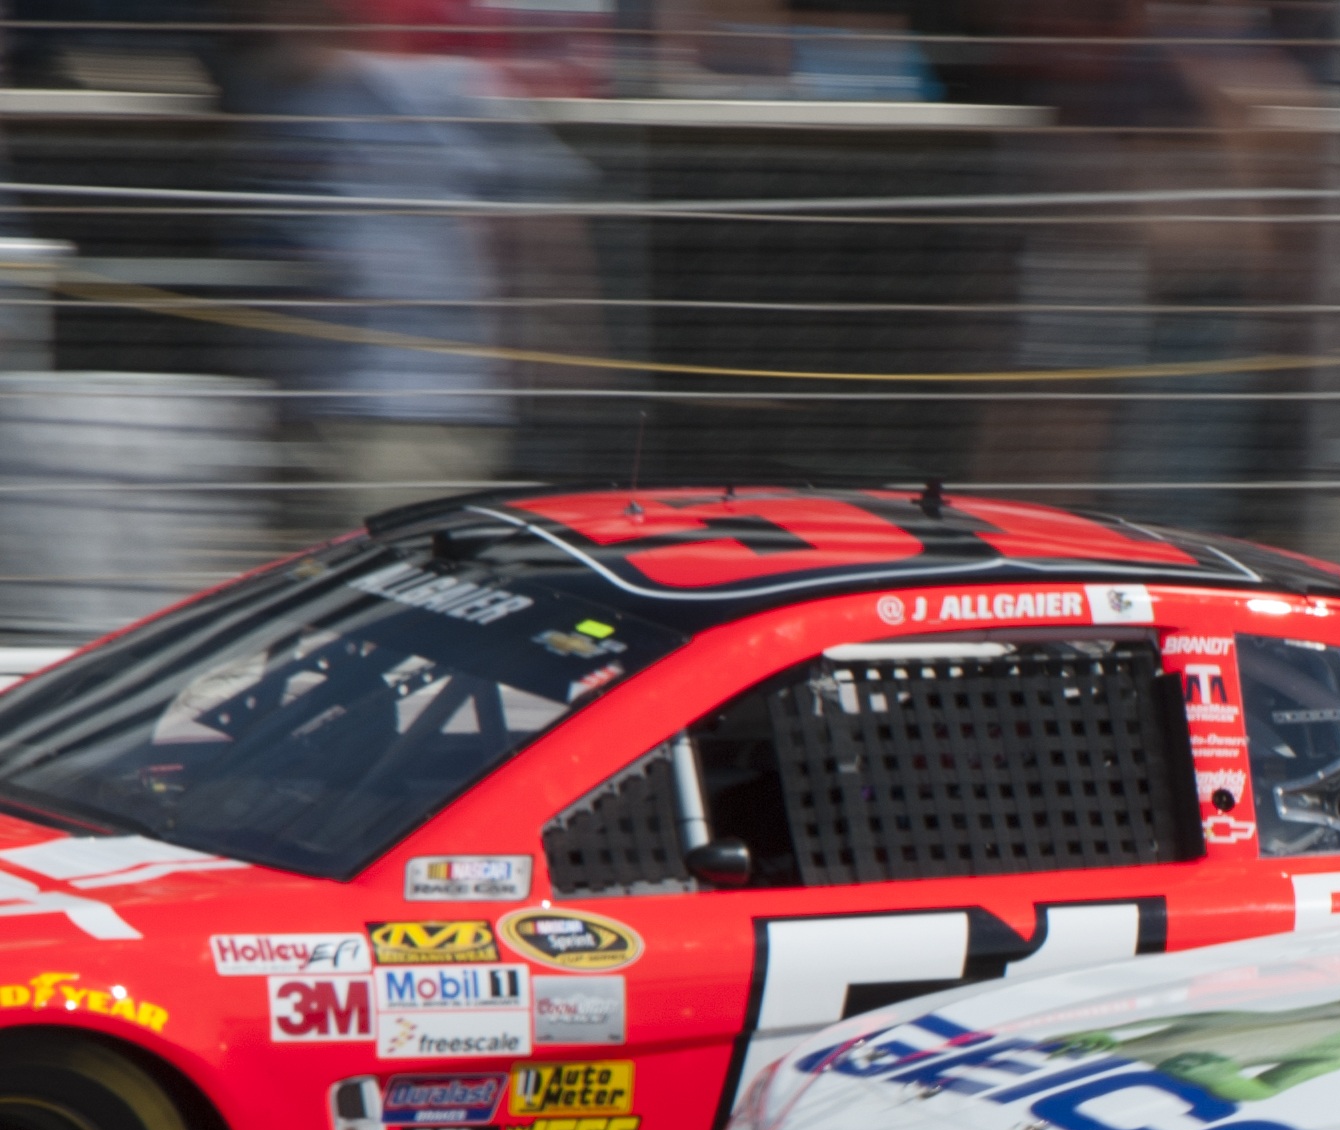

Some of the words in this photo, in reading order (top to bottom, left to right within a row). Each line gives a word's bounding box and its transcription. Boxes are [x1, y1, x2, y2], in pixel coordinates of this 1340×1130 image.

[1162, 635, 1234, 655] BRANDT
[215, 938, 309, 970] Holley
[386, 971, 480, 1000] Mobil
[489, 970, 519, 997] 1
[276, 981, 371, 1036] 3M
[418, 1032, 521, 1053] freescale
[547, 1065, 612, 1086] Auto
[389, 1079, 497, 1106] Duralast
[543, 1087, 625, 1107] Meter
